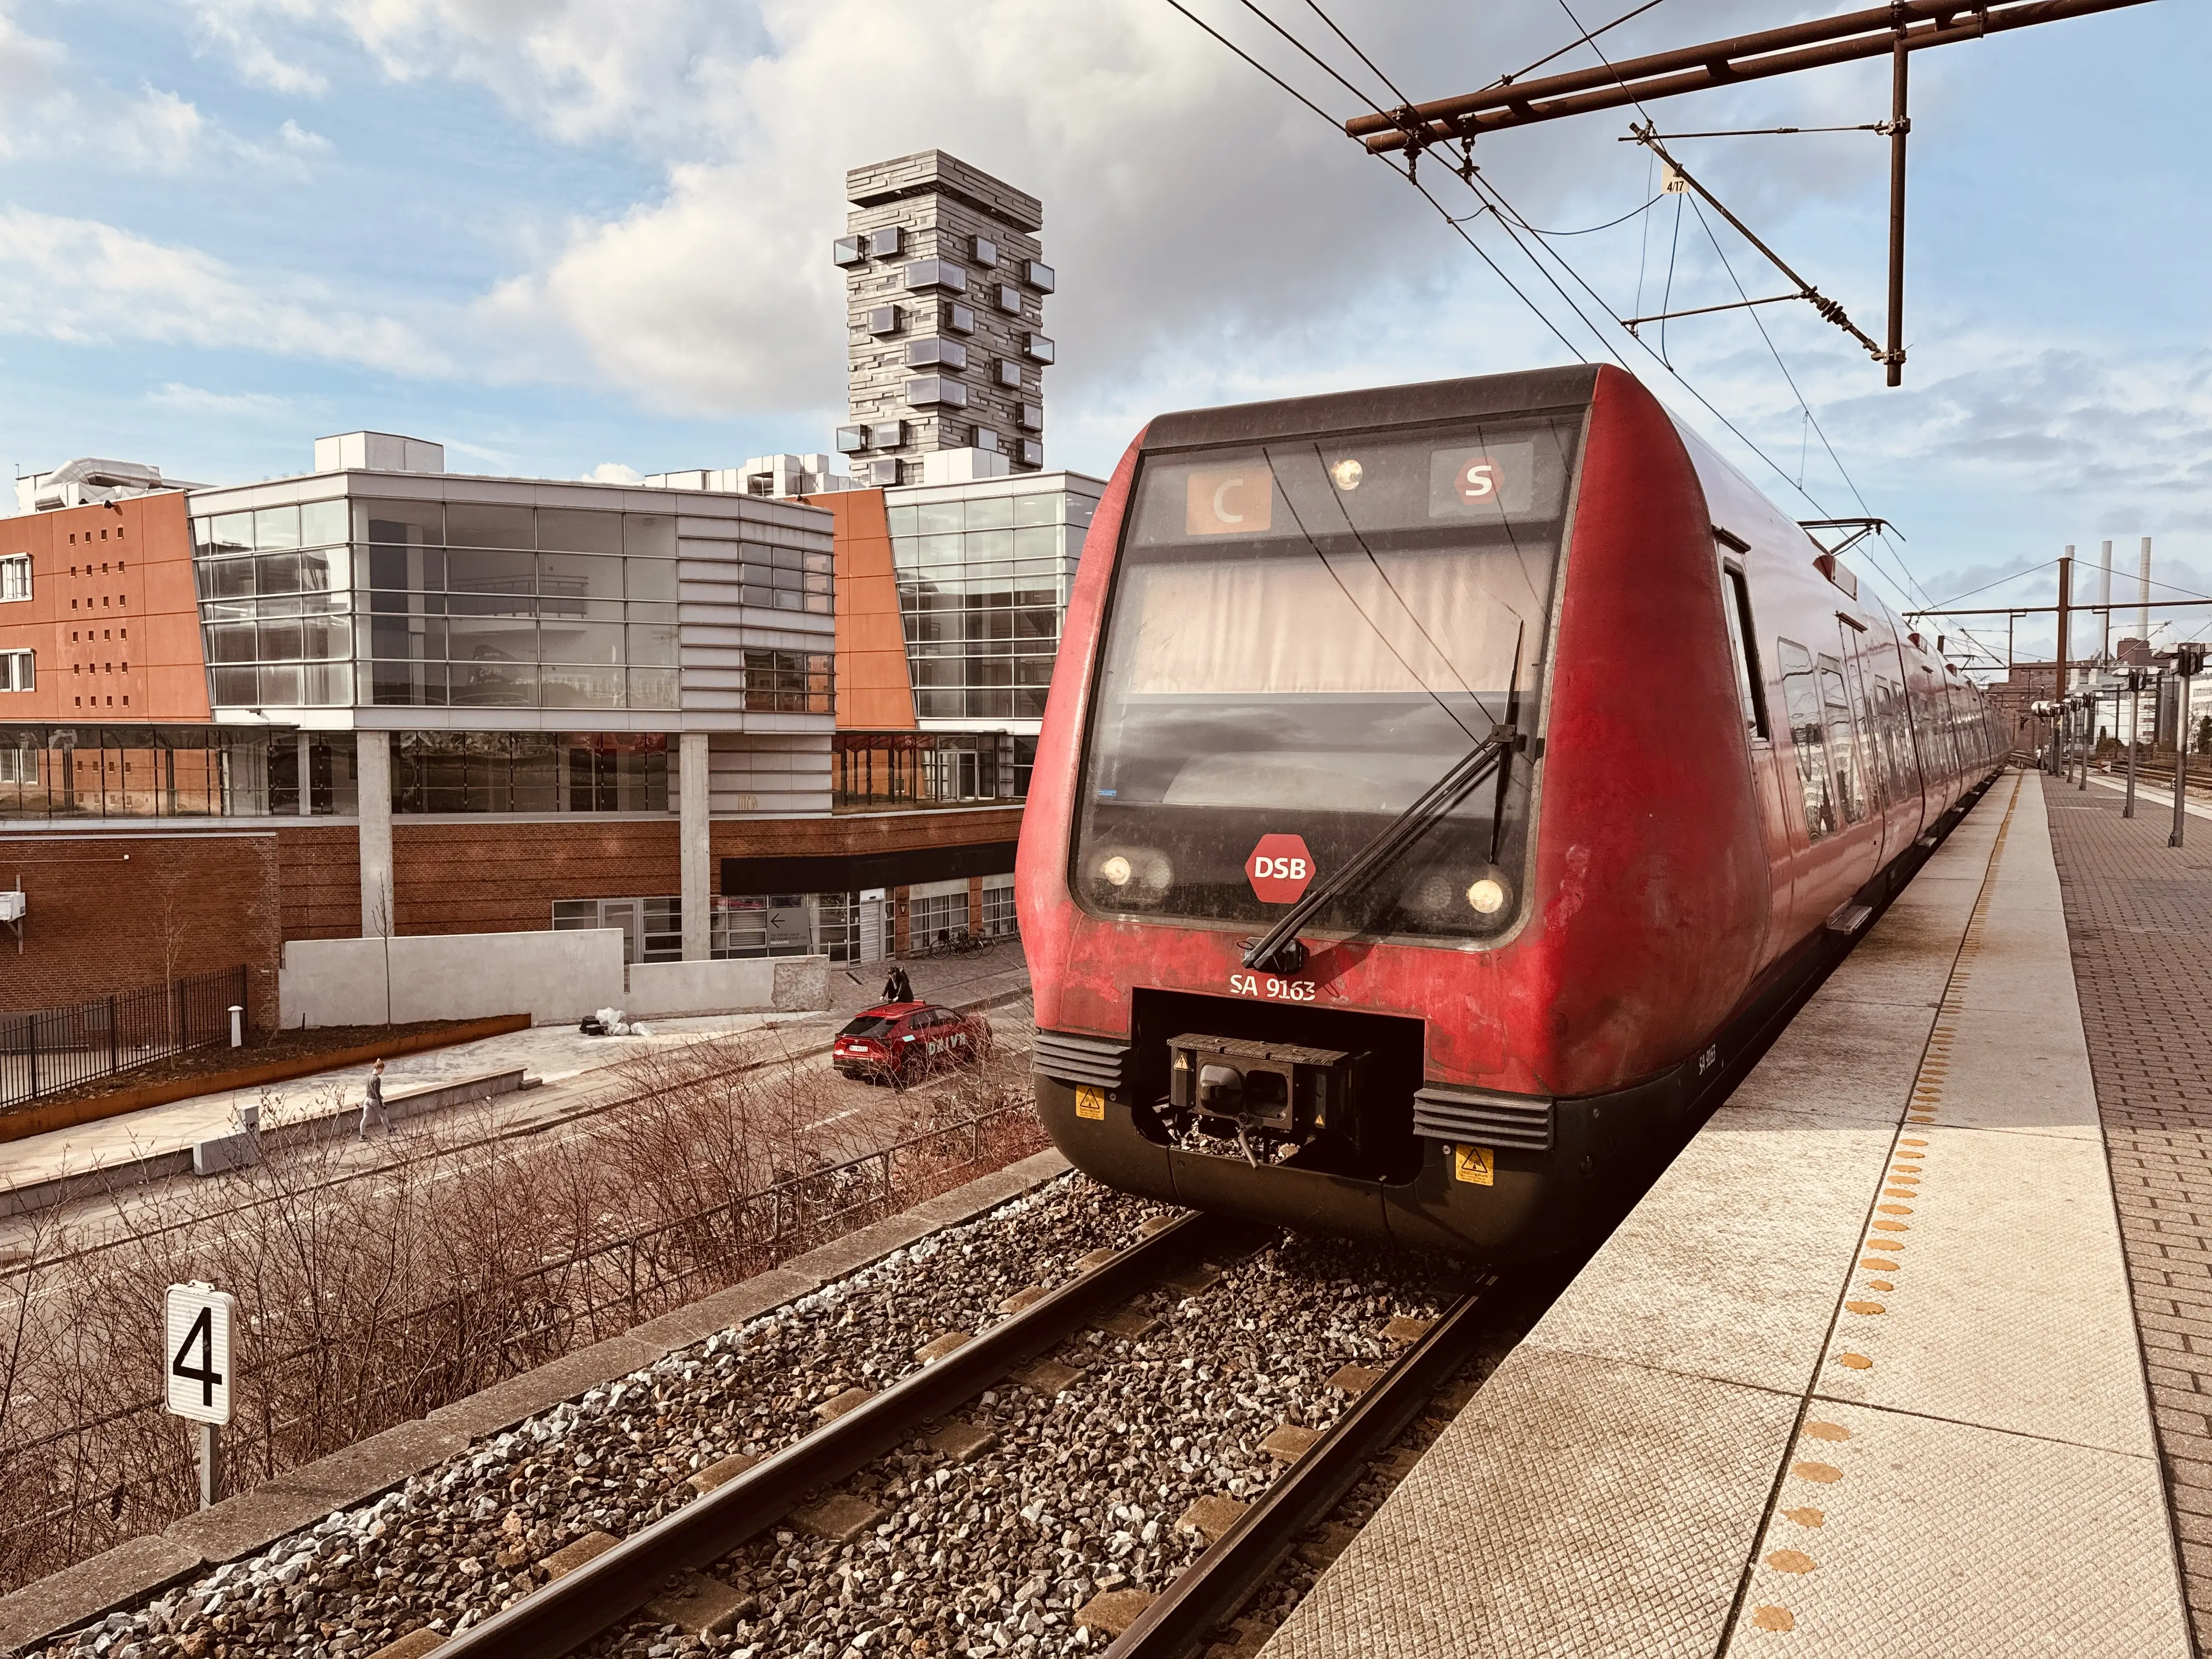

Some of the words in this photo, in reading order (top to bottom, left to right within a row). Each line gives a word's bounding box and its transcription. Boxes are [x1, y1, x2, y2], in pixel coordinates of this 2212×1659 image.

[1667, 180, 1684, 192] 4/17
[1466, 465, 1492, 496] S
[1214, 478, 1243, 523] C
[1255, 856, 1306, 879] DSB
[1230, 974, 1258, 996] SA
[1266, 978, 1316, 1001] 9163
[1699, 1054, 1705, 1076] SA
[173, 1307, 222, 1407] 4
